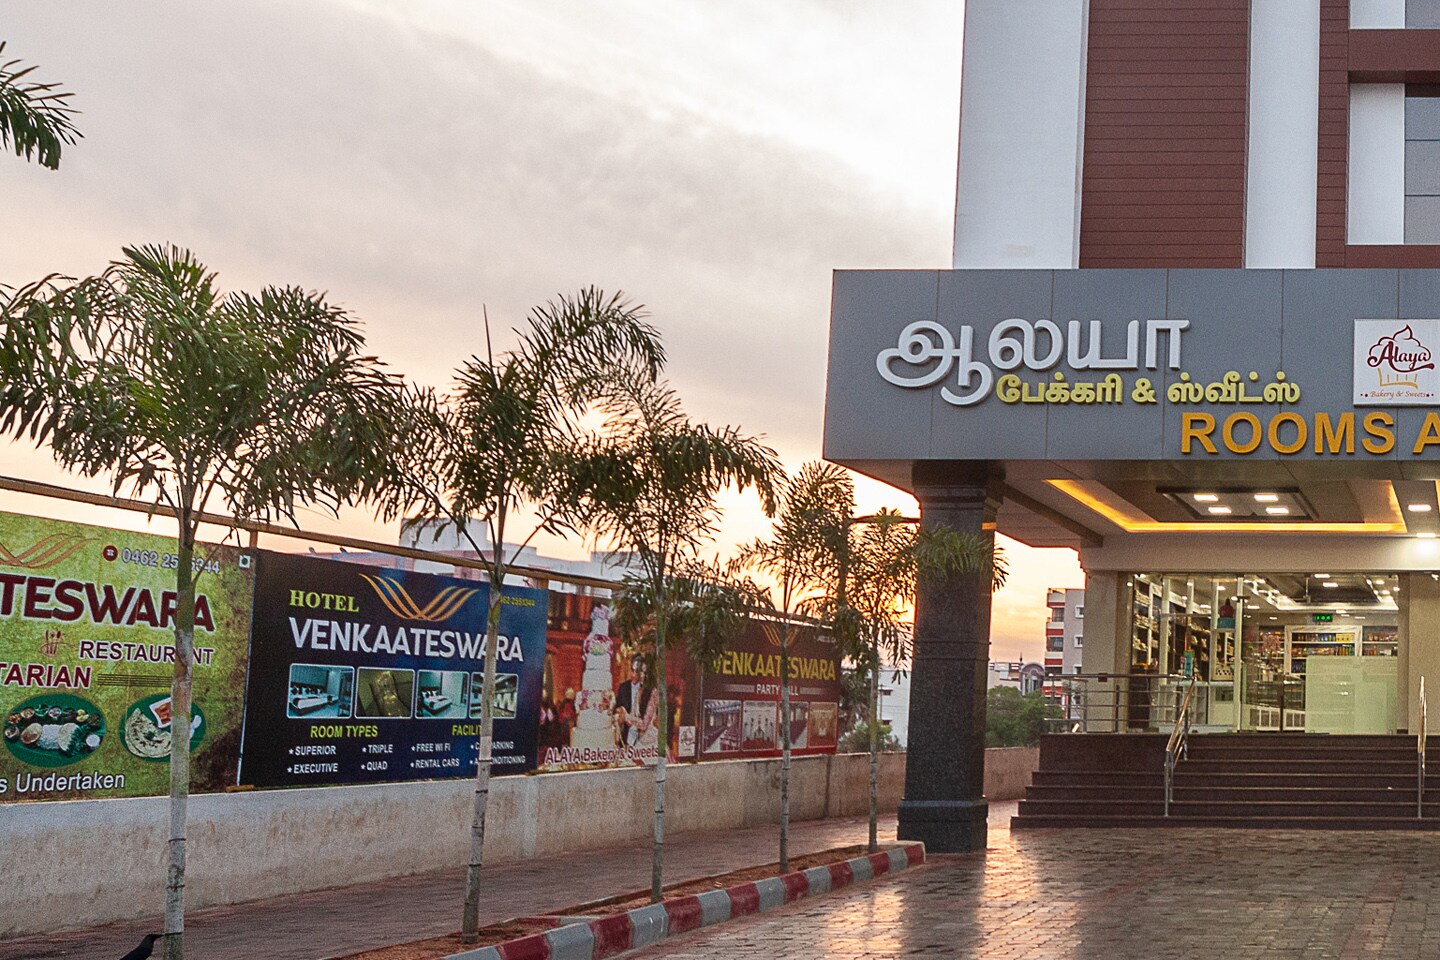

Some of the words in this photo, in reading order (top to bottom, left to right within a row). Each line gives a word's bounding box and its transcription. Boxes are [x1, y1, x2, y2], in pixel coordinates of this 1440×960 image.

[876, 318, 1190, 406] ஆலயா
[1367, 340, 1435, 373] Alaya
[996, 372, 1123, 403] பேக்கரி
[1131, 377, 1158, 403] &
[1167, 371, 1300, 403] ஸ்வீட்ஸ்
[1370, 389, 1394, 400] Bakery
[1181, 411, 1396, 455] ROOMS
[122, 548, 158, 567] 0462
[289, 590, 360, 613] HOTEL
[289, 617, 524, 662] VENKAATESWARA
[79, 640, 214, 665] RESTAURNT
[756, 684, 779, 696] PARTY
[310, 725, 343, 738] ROOM
[346, 725, 378, 738] TYPES
[294, 745, 337, 756] SUPERIOR
[368, 743, 393, 754] TRIPLE
[416, 743, 434, 752] FREE
[491, 741, 514, 750] ARKING
[544, 747, 582, 765] ALAYA
[583, 746, 616, 762] Bakery
[628, 744, 659, 759] Sweets
[293, 763, 338, 774] EXECUTIVE
[366, 761, 388, 771] QUAD
[415, 759, 441, 769] RENTAL
[442, 758, 460, 767] CARS
[16, 771, 125, 793] Undertaken
